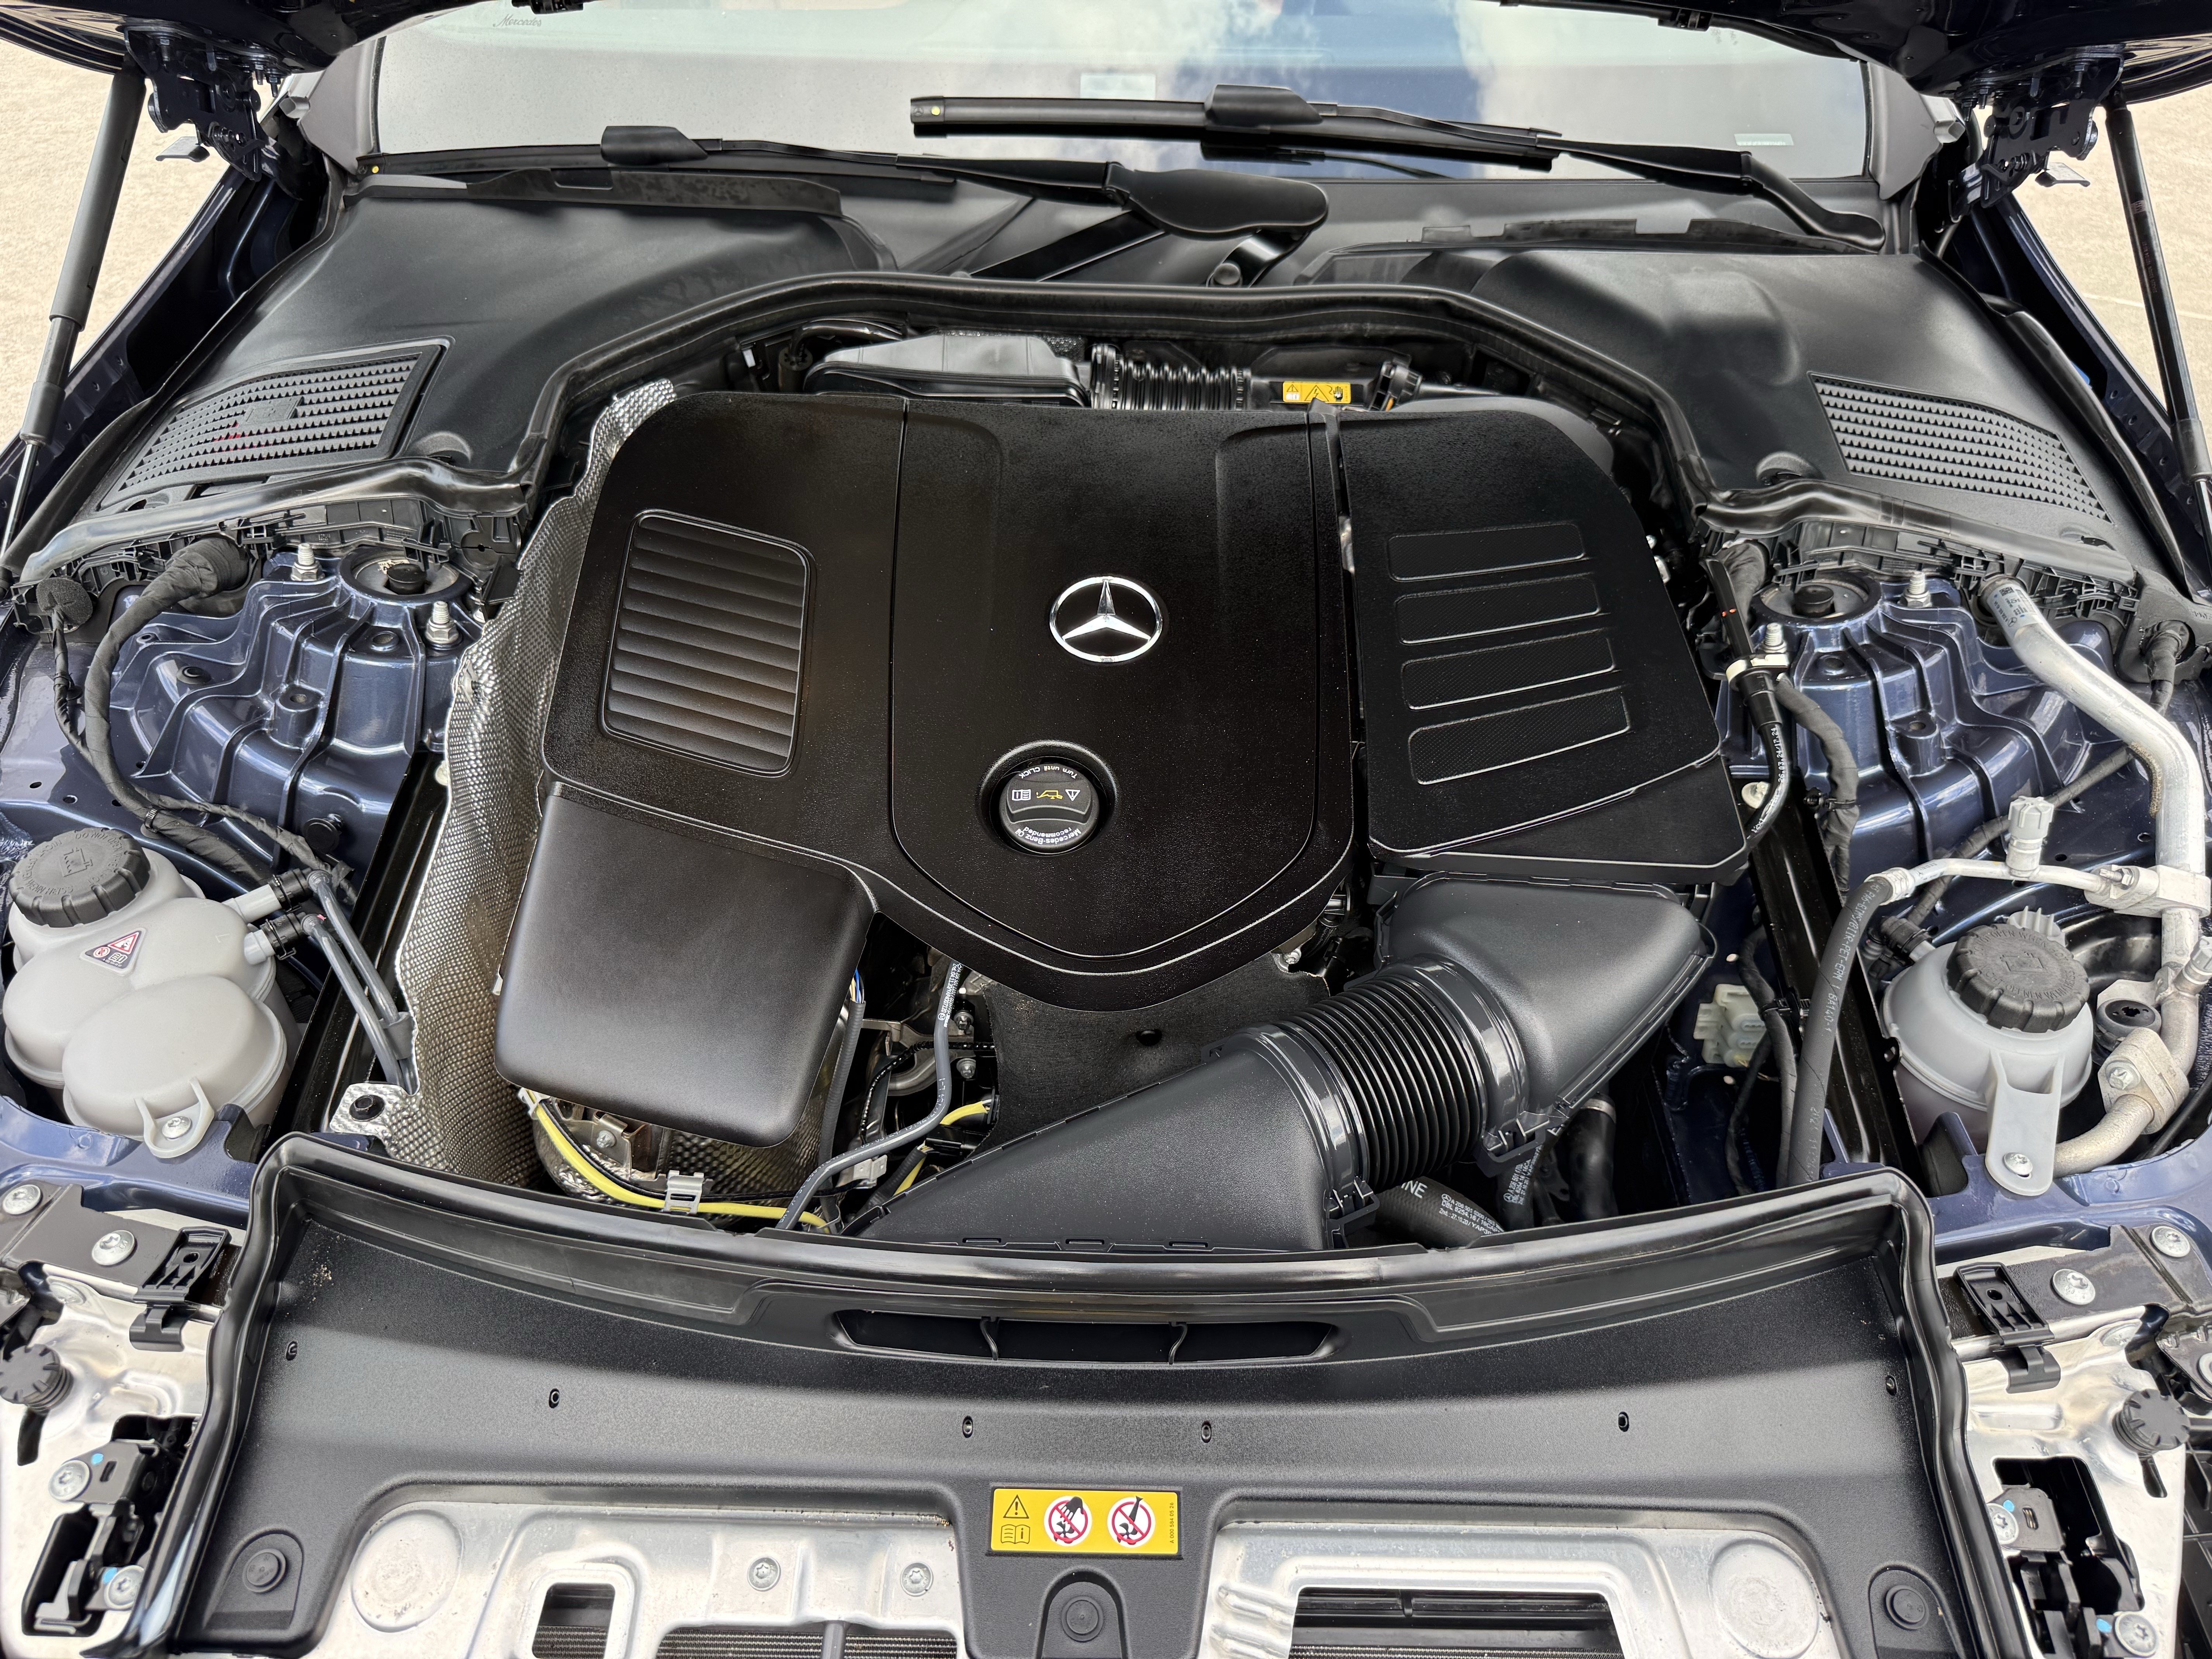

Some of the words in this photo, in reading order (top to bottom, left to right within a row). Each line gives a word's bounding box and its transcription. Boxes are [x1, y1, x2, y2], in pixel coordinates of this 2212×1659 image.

[493, 14, 541, 27] Mercedes
[1018, 767, 1041, 779] CLICK
[1062, 768, 1078, 779] Turn
[1015, 828, 1025, 837] Oil
[1023, 826, 1072, 838] recommended
[1025, 828, 1082, 845] Mercedes-Benz
[1441, 1200, 1453, 1211] DBL
